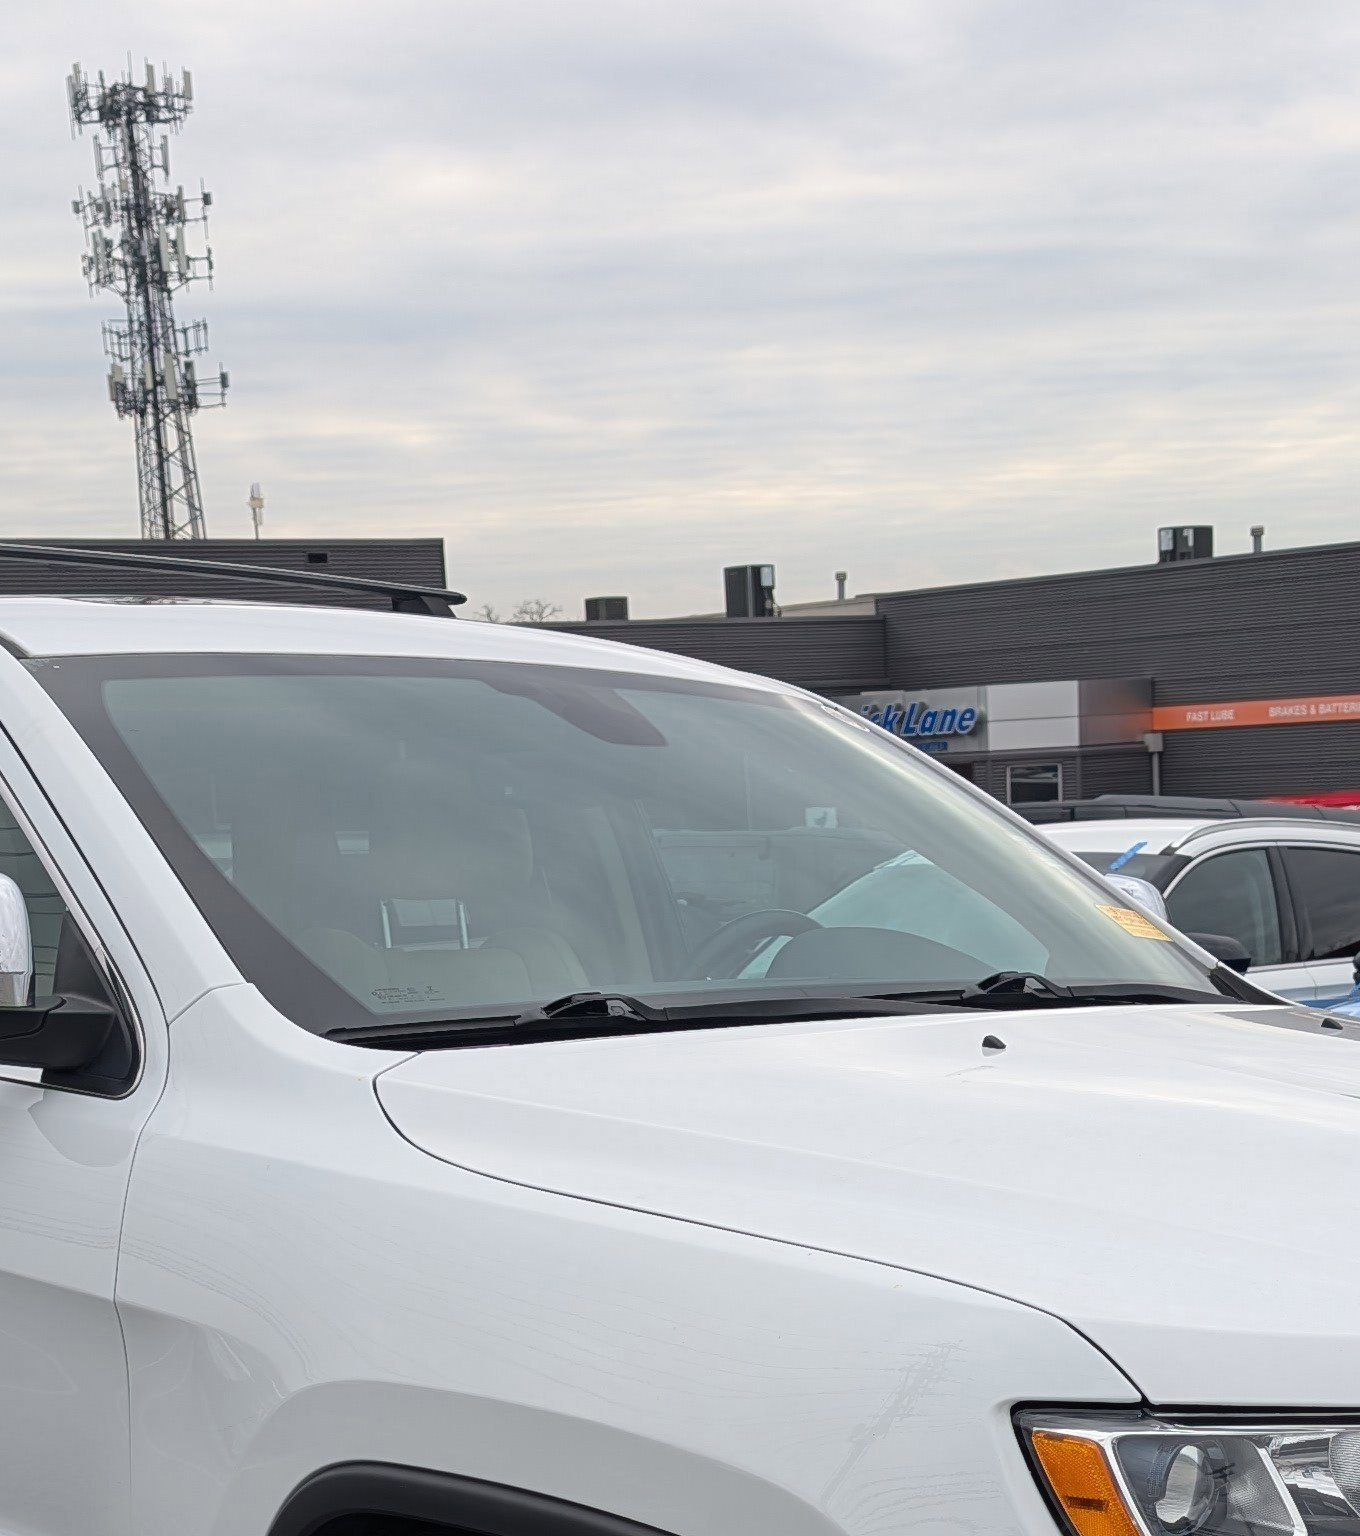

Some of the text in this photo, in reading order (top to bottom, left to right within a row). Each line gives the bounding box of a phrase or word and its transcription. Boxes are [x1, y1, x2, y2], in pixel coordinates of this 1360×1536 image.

[1186, 709, 1234, 722] FAST LUBE
[1268, 704, 1308, 717] BRAKES
[899, 702, 978, 736] Lane
